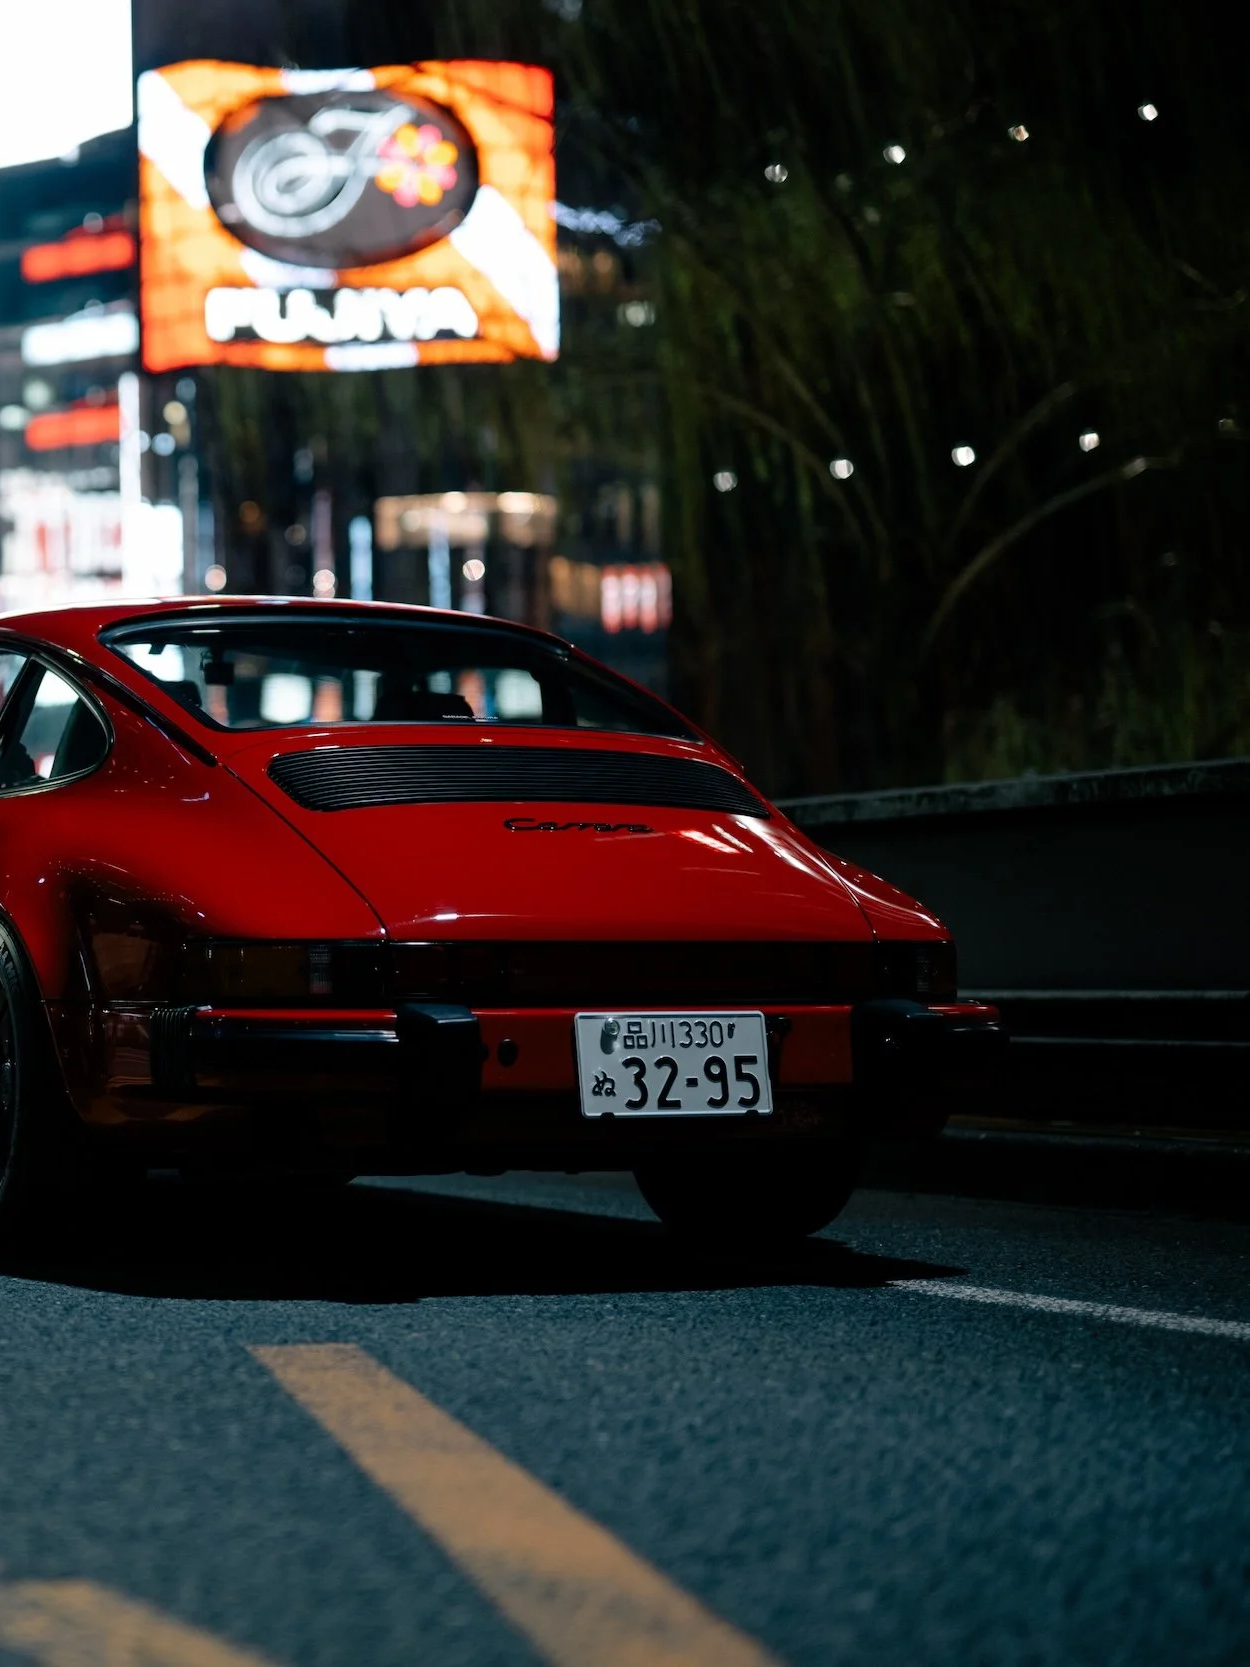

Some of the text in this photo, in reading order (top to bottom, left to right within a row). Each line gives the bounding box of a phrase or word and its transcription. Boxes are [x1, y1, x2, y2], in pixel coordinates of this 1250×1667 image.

[205, 286, 479, 343] FUJIYA
[503, 817, 655, 833] Carrera
[591, 1055, 761, 1110] ぬ 32-95
